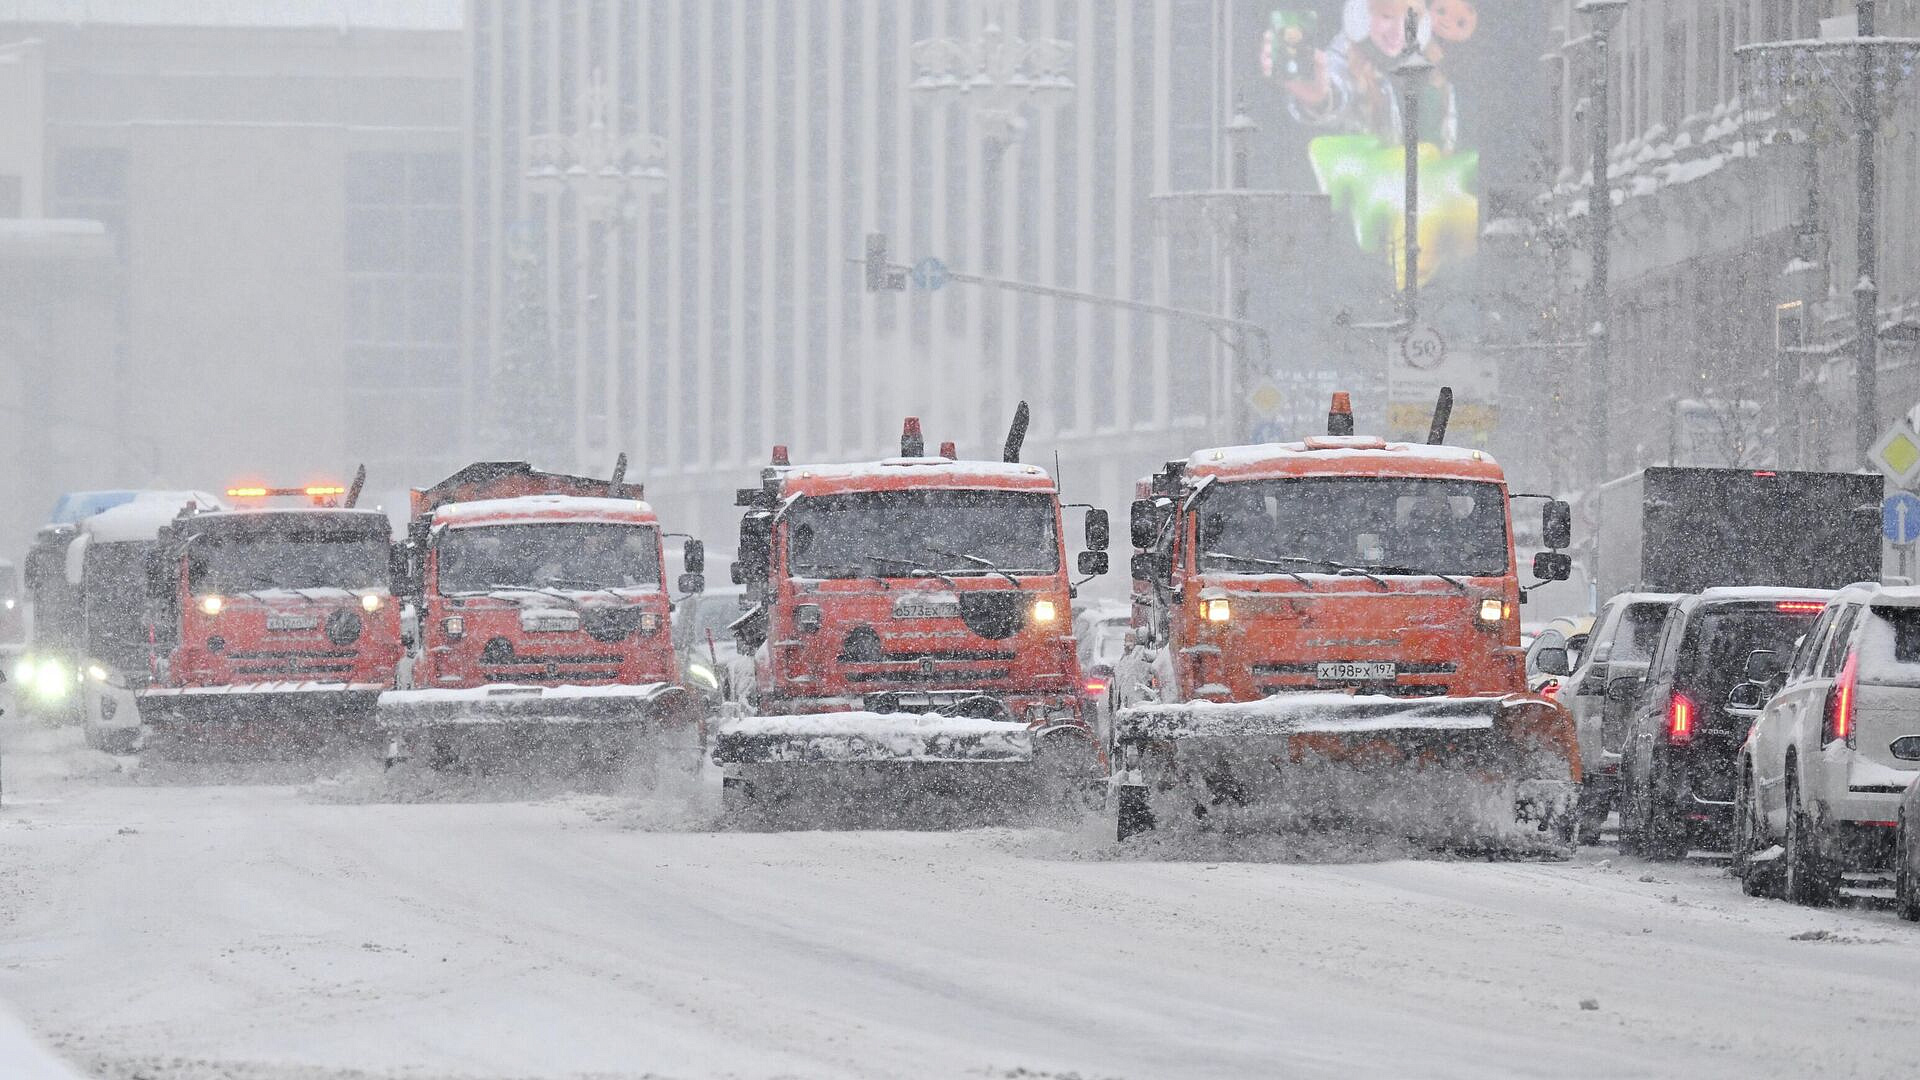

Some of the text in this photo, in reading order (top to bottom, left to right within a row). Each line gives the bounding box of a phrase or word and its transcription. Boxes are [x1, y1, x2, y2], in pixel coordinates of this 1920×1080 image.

[1412, 339, 1436, 358] 50
[1322, 663, 1392, 678] Х198РХ 197
